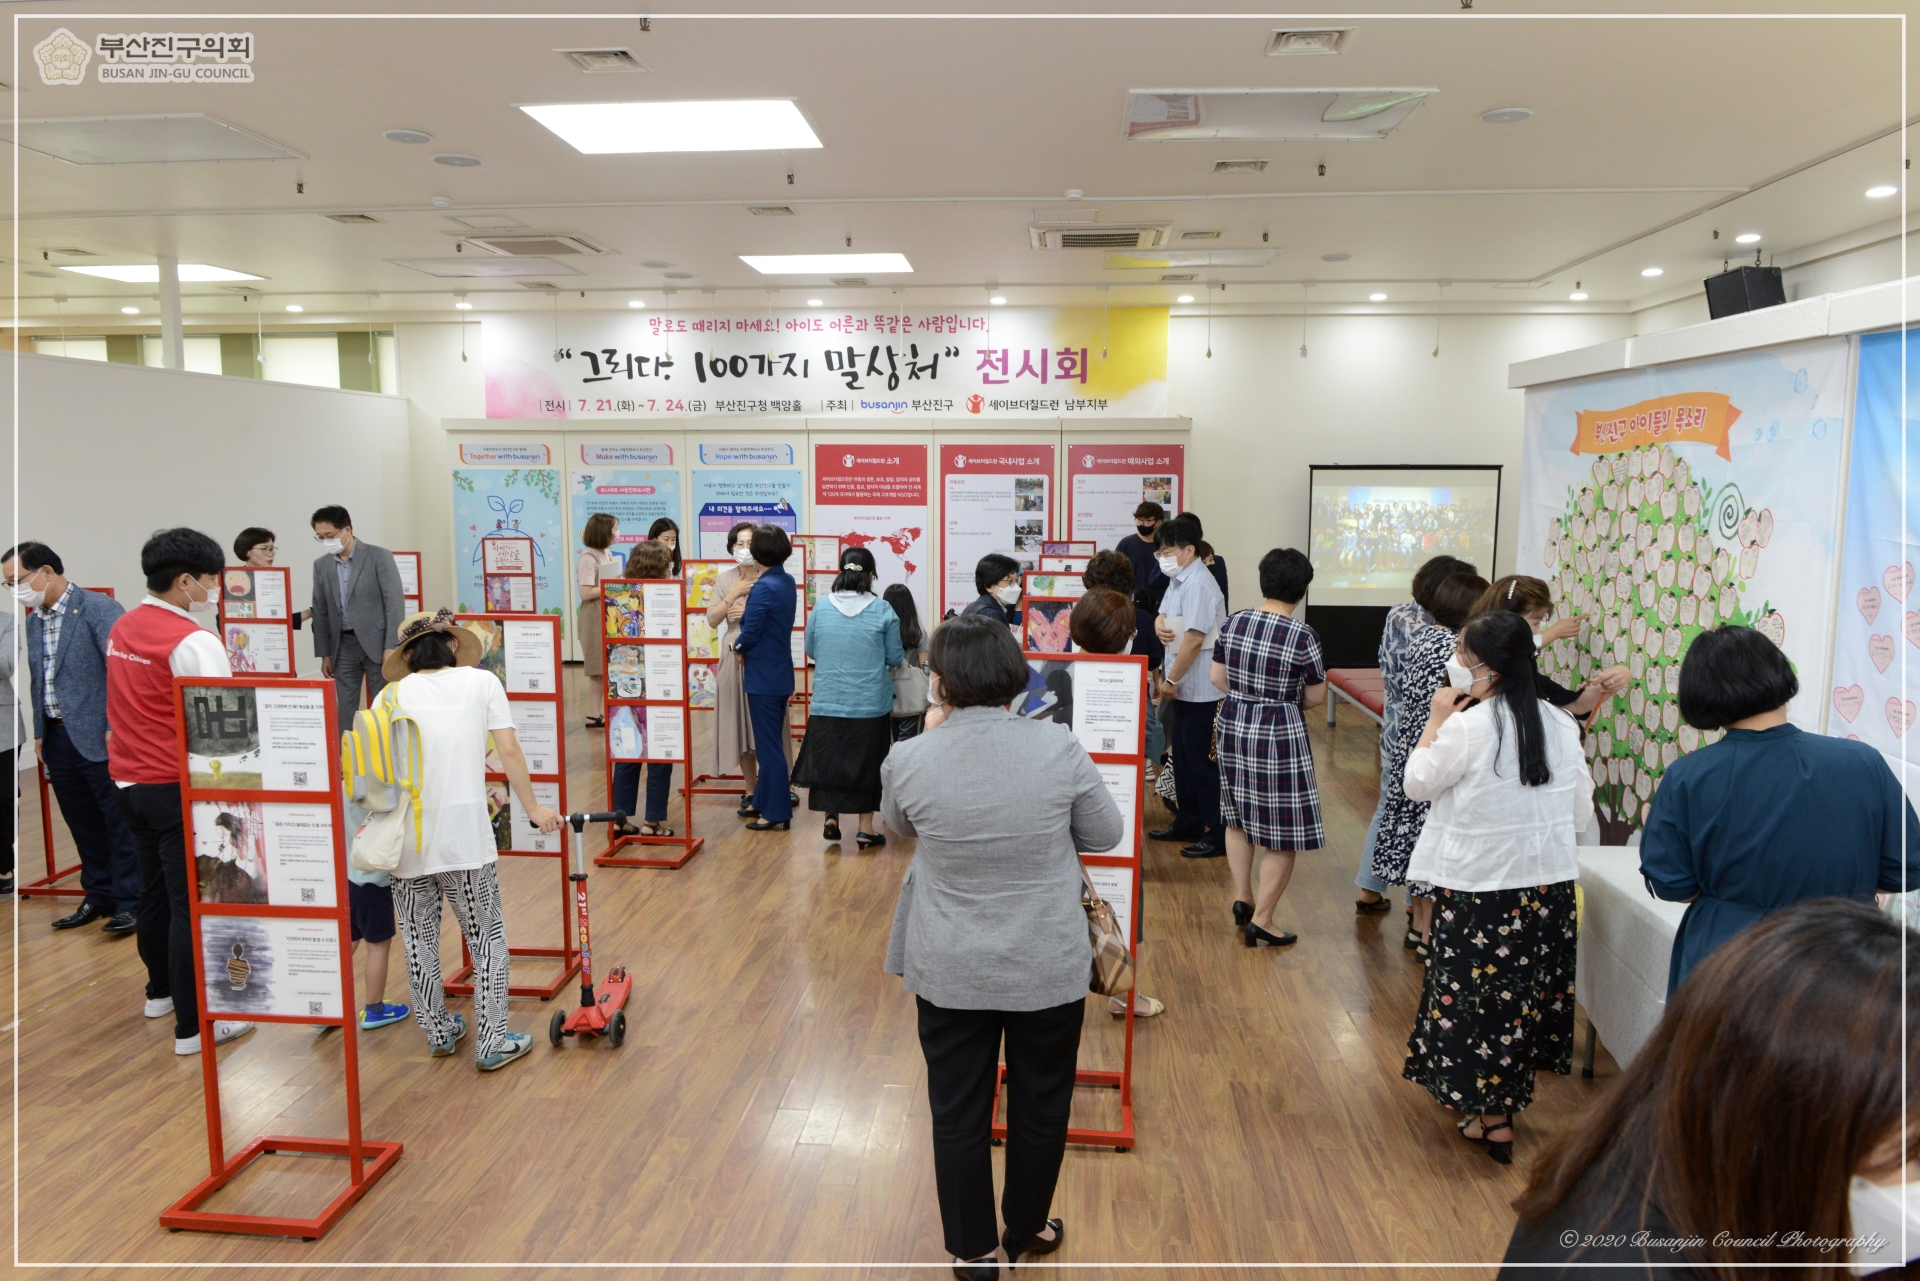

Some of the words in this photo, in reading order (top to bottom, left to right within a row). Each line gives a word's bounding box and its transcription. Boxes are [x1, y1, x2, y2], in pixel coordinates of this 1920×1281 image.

[648, 317, 688, 336] 말로도
[692, 318, 731, 333] 때리지
[735, 317, 781, 334] 마세요!
[785, 317, 824, 333] 아이도
[829, 315, 869, 334] 어른과
[874, 315, 912, 334] 똑같은
[694, 350, 809, 383] 100가지
[975, 347, 1088, 385] 전시회
[715, 400, 767, 412] 부산진구청
[770, 400, 803, 412] 백양홀
[826, 400, 847, 411] 주최
[860, 400, 908, 413] busanjin
[911, 399, 954, 412] 부산진구
[988, 399, 1060, 412] 세이브더칠드런
[1064, 399, 1109, 411] 남부지부
[1629, 408, 1672, 436] 아이들의
[1674, 406, 1708, 434] 목소리
[512, 453, 541, 461] busanjin
[629, 453, 658, 461] busanjin
[749, 453, 778, 461] busanjin
[886, 457, 900, 465] 소개
[998, 457, 1025, 465] 국내사업
[1026, 457, 1040, 465] 소개
[1127, 457, 1154, 465] 해외사업
[1156, 457, 1170, 465] 소개
[717, 505, 734, 513] 의견을
